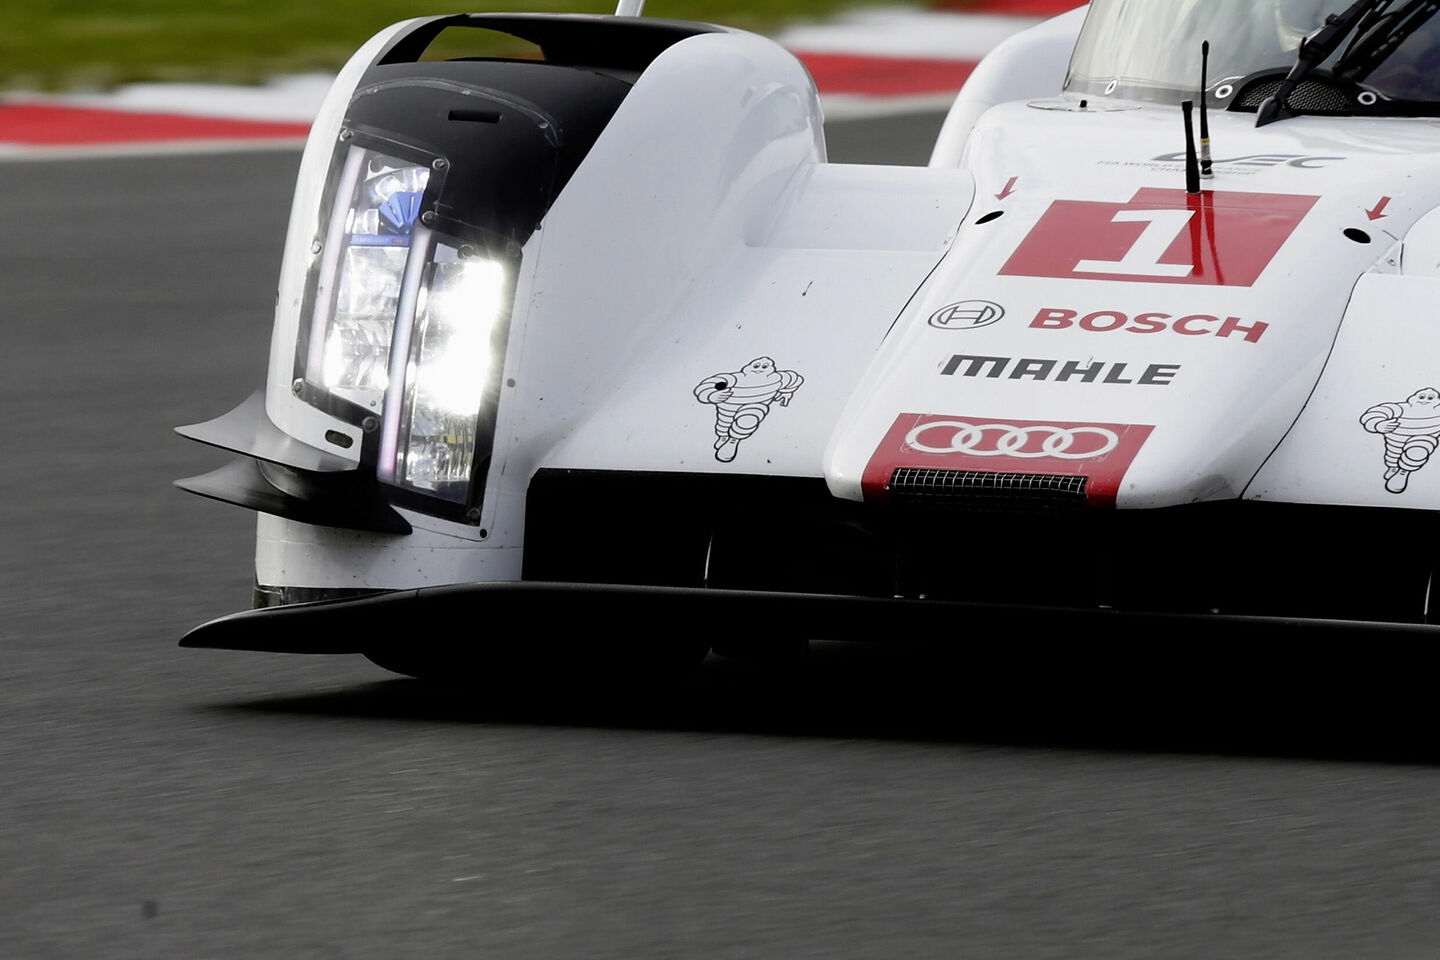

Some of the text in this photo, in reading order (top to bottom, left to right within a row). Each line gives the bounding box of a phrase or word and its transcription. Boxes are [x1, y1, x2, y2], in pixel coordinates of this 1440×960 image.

[1072, 209, 1197, 277] 1
[1028, 308, 1269, 343] BOSCH
[940, 354, 1181, 385] MAHLE
